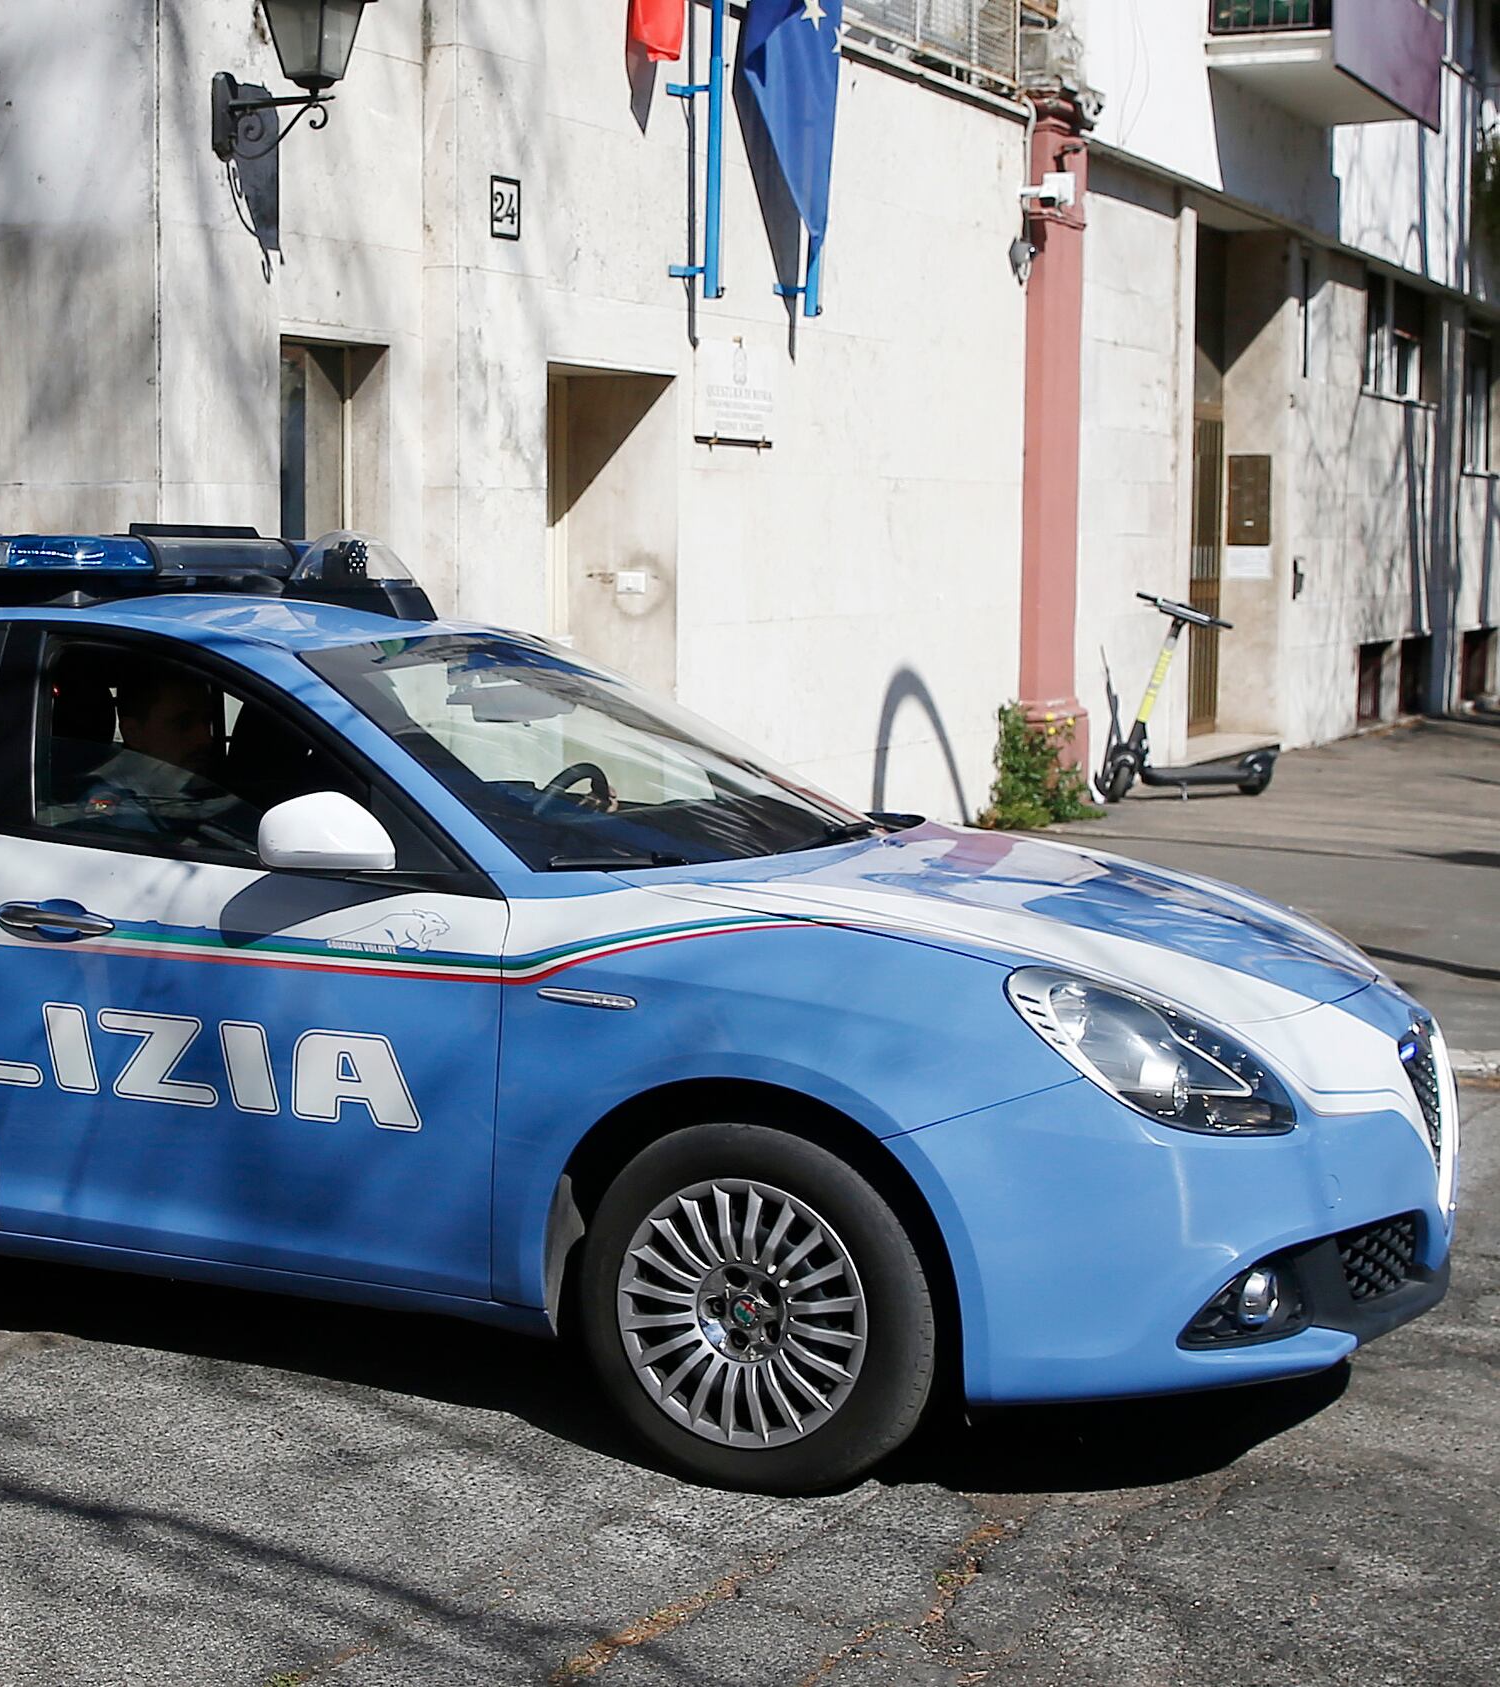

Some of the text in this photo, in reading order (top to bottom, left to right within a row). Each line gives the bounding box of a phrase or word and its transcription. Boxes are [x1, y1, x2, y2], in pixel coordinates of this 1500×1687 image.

[493, 191, 517, 225] 24
[327, 939, 399, 955] SQUADRA VOLANTE
